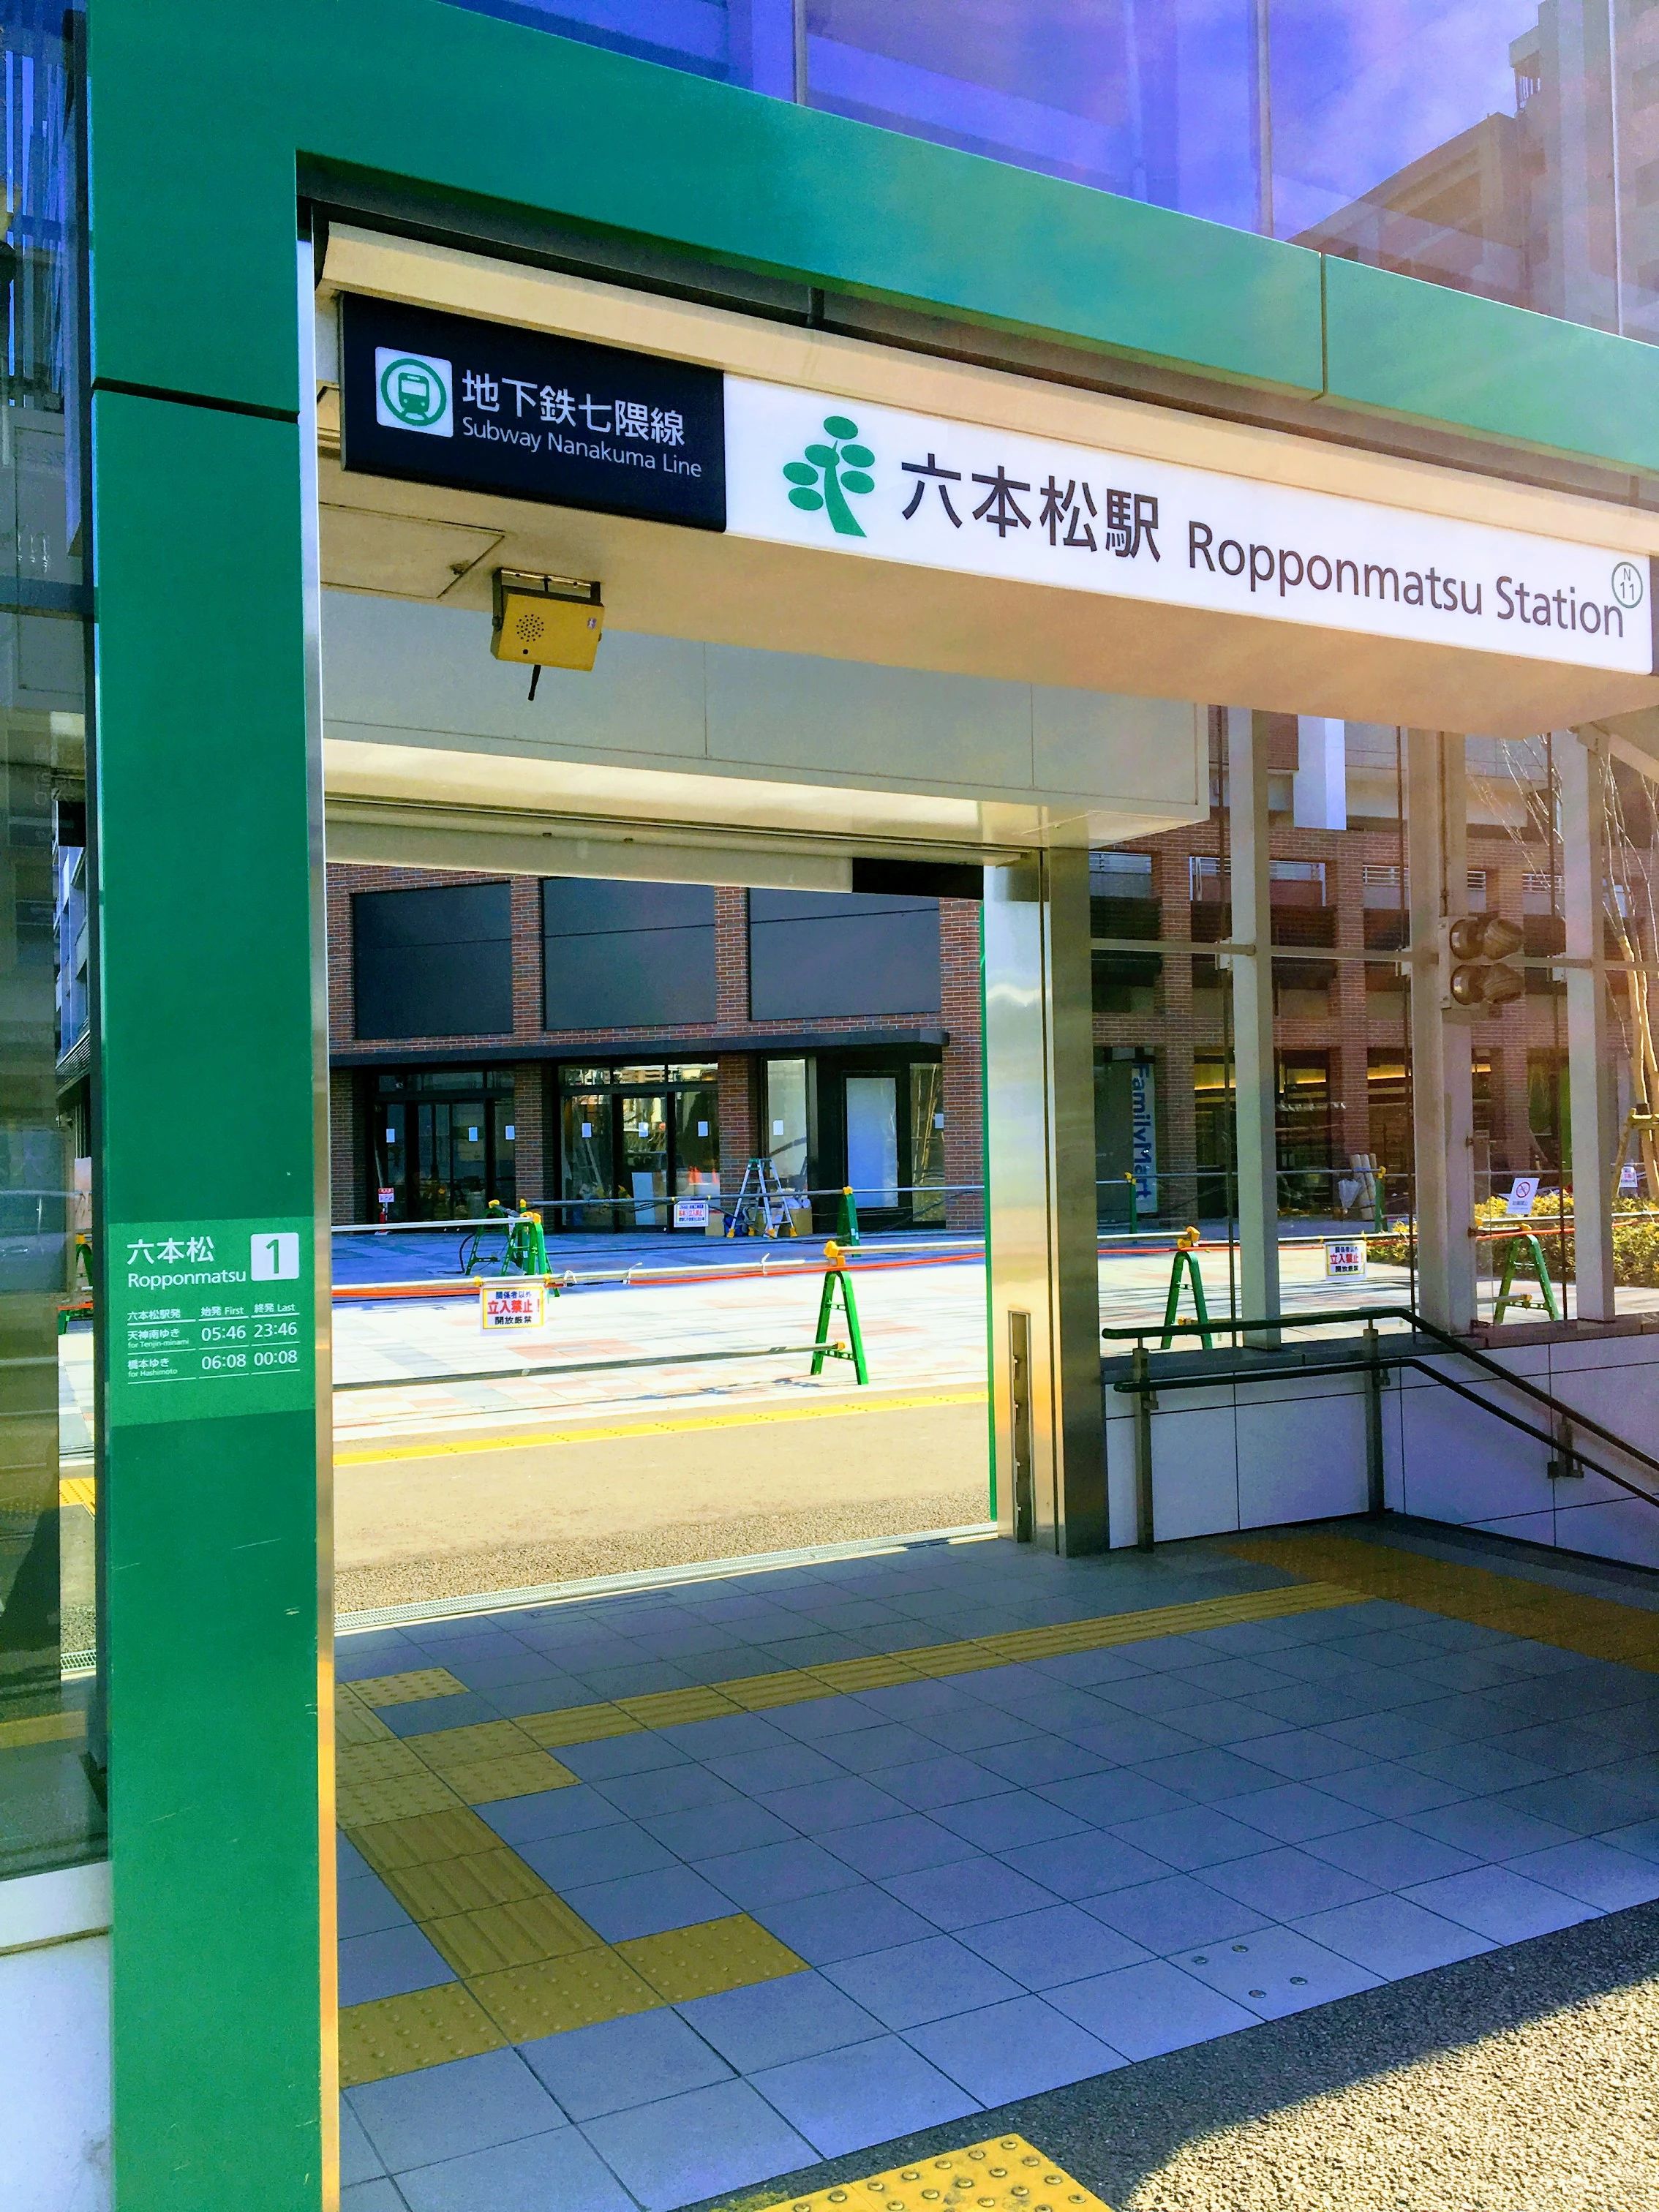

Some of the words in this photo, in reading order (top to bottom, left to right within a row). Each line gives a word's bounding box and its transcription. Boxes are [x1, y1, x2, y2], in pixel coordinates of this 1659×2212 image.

[462, 370, 685, 446] 地下鉄七隈線
[463, 417, 541, 453] Subway
[548, 433, 655, 470] Nanakuma
[663, 454, 702, 478] Line
[901, 453, 1161, 563] 六本松駅
[1189, 521, 1483, 615] Ropponmatsu
[1497, 576, 1624, 638] Station
[1623, 568, 1631, 582] N
[1620, 582, 1634, 601] 11
[1132, 1064, 1152, 1199] FamilyMart
[127, 1236, 214, 1265] 六本松
[265, 1239, 279, 1274] 1
[127, 1270, 247, 1290] Ropponmatsu
[127, 1309, 181, 1321] 六本松駅発
[200, 1306, 222, 1317] 始発
[225, 1306, 244, 1315] First
[254, 1303, 274, 1313] 終発
[277, 1304, 296, 1312] Last
[127, 1328, 180, 1340] 天神南ゆき
[201, 1325, 246, 1342] 05:46
[254, 1322, 297, 1338] 23:46
[140, 1338, 189, 1348] Tenjin-minami
[201, 1353, 247, 1369] 06:08
[254, 1350, 298, 1366] 00:08
[140, 1369, 178, 1377] Hashimoto
